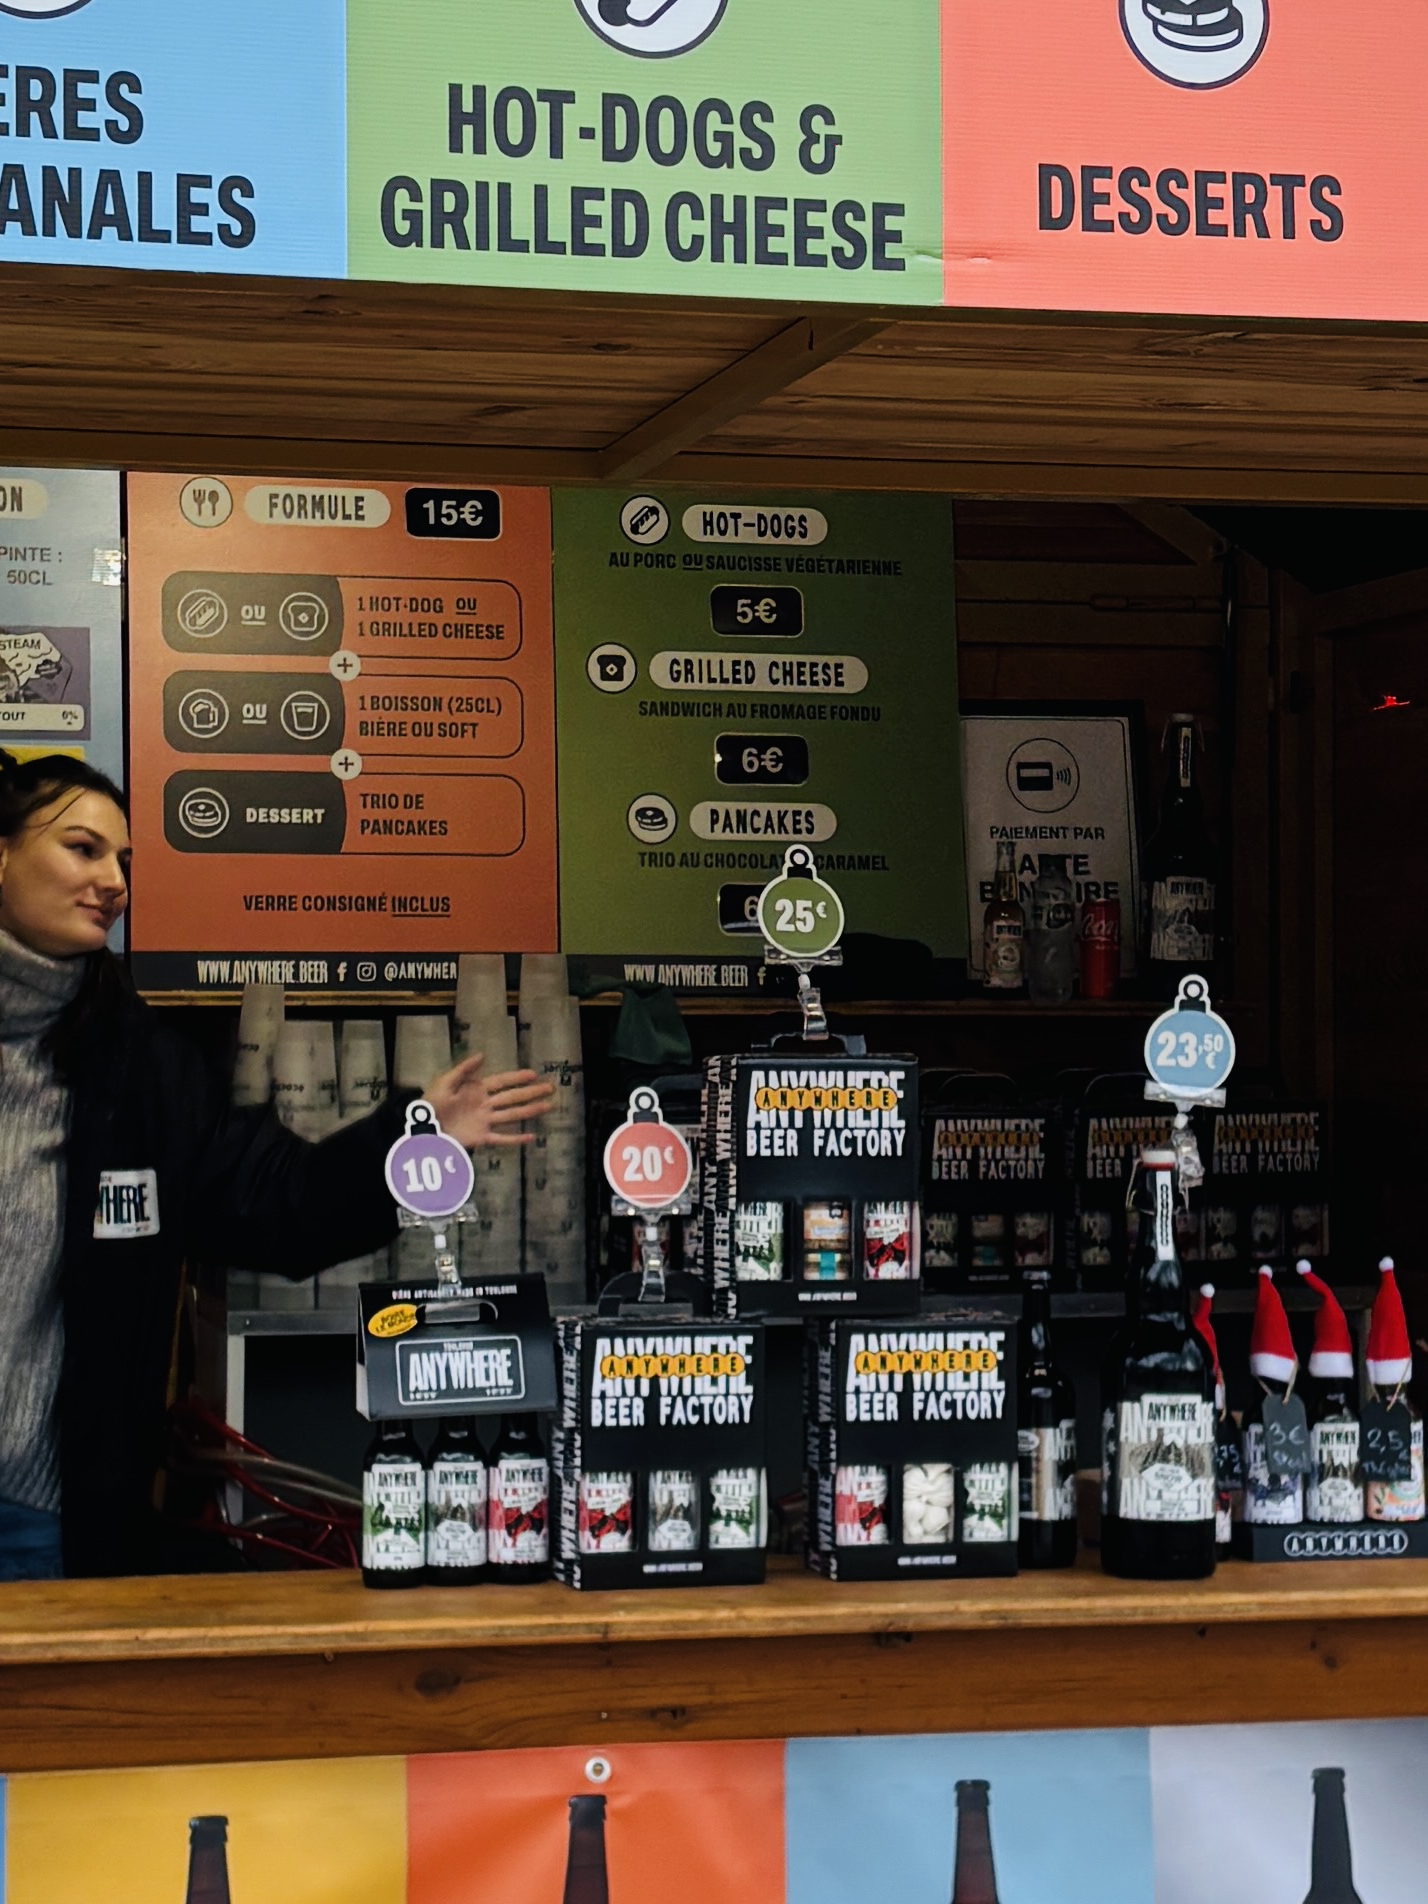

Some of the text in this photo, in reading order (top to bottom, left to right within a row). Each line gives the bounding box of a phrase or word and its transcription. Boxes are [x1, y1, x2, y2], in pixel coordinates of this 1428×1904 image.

[447, 84, 842, 174] HOT-DOGS &
[1038, 162, 1344, 242] DESSERTS
[379, 175, 906, 272] GRILLED CHEESE
[269, 493, 366, 521] FORMULE
[422, 499, 483, 526] 15€
[702, 511, 808, 539] HOT-DOGS
[633, 553, 782, 573] PORC SAUCISSE
[7, 570, 54, 586] 50CL
[736, 598, 777, 624] 5€
[370, 623, 505, 640] GRILLED CHEESE
[669, 658, 844, 687] GRILLED CHEESE
[371, 695, 502, 715] BOISSON (25CL)
[638, 700, 881, 722] SANDWICH AU FONDU
[359, 717, 479, 739] BIÈRE OU SOFT
[742, 747, 783, 773] 6€
[360, 793, 424, 810] TRIO DE
[246, 807, 325, 824] DESSERT
[360, 819, 448, 836] PANCAKES
[710, 808, 815, 835] PANCAKES
[990, 825, 1105, 840] PAIEMENT PAR
[638, 851, 701, 868] TRIO AU
[244, 892, 451, 913] VERRE CONSIGNÉ INCLUS
[775, 899, 827, 933] 25€
[746, 1129, 906, 1157] BEER FACTORY
[402, 1156, 455, 1194] 10€
[622, 1145, 674, 1183] 20€
[409, 1349, 514, 1391] ANYWHERE
[591, 1396, 753, 1427] BEER FACTORY
[845, 1391, 1006, 1422] BEER FACTORY
